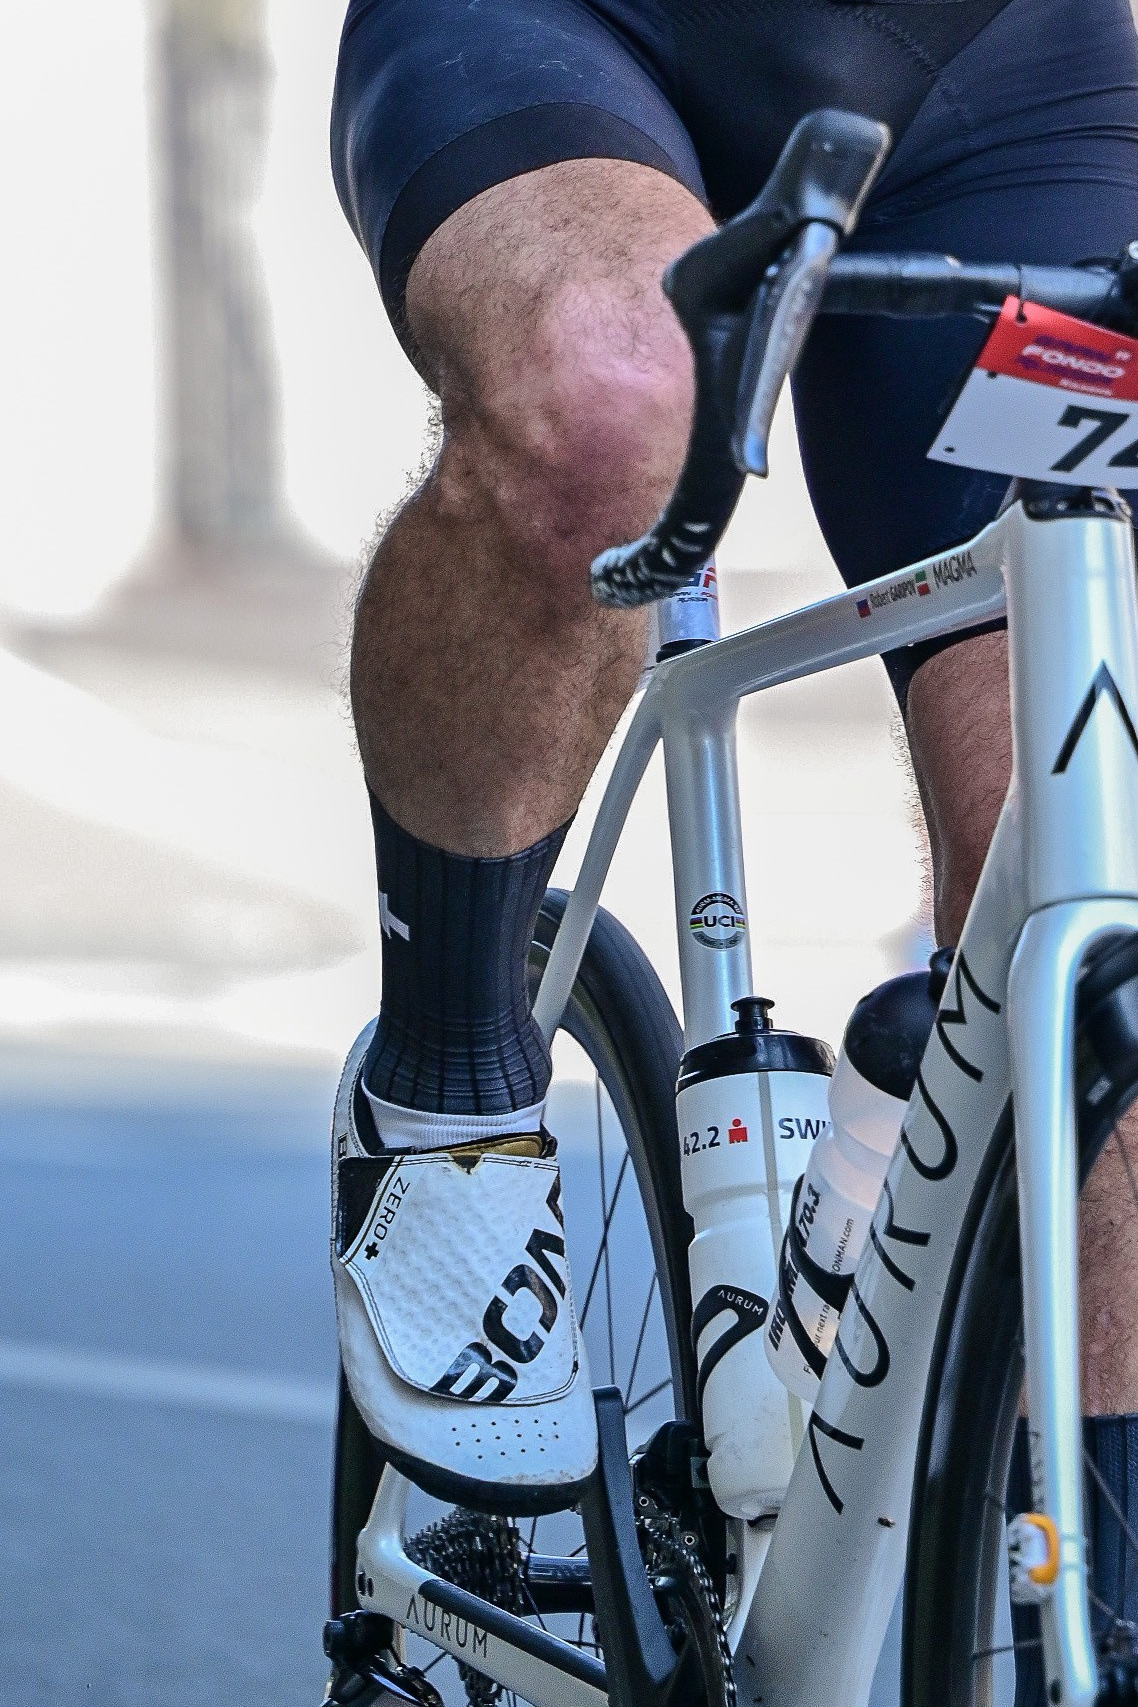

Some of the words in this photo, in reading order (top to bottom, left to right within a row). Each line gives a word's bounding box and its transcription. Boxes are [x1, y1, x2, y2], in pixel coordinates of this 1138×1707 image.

[932, 550, 978, 590] MAGMA
[703, 915, 736, 928] UCI
[717, 1289, 764, 1316] AURUM
[406, 1593, 488, 1659] AURUM
